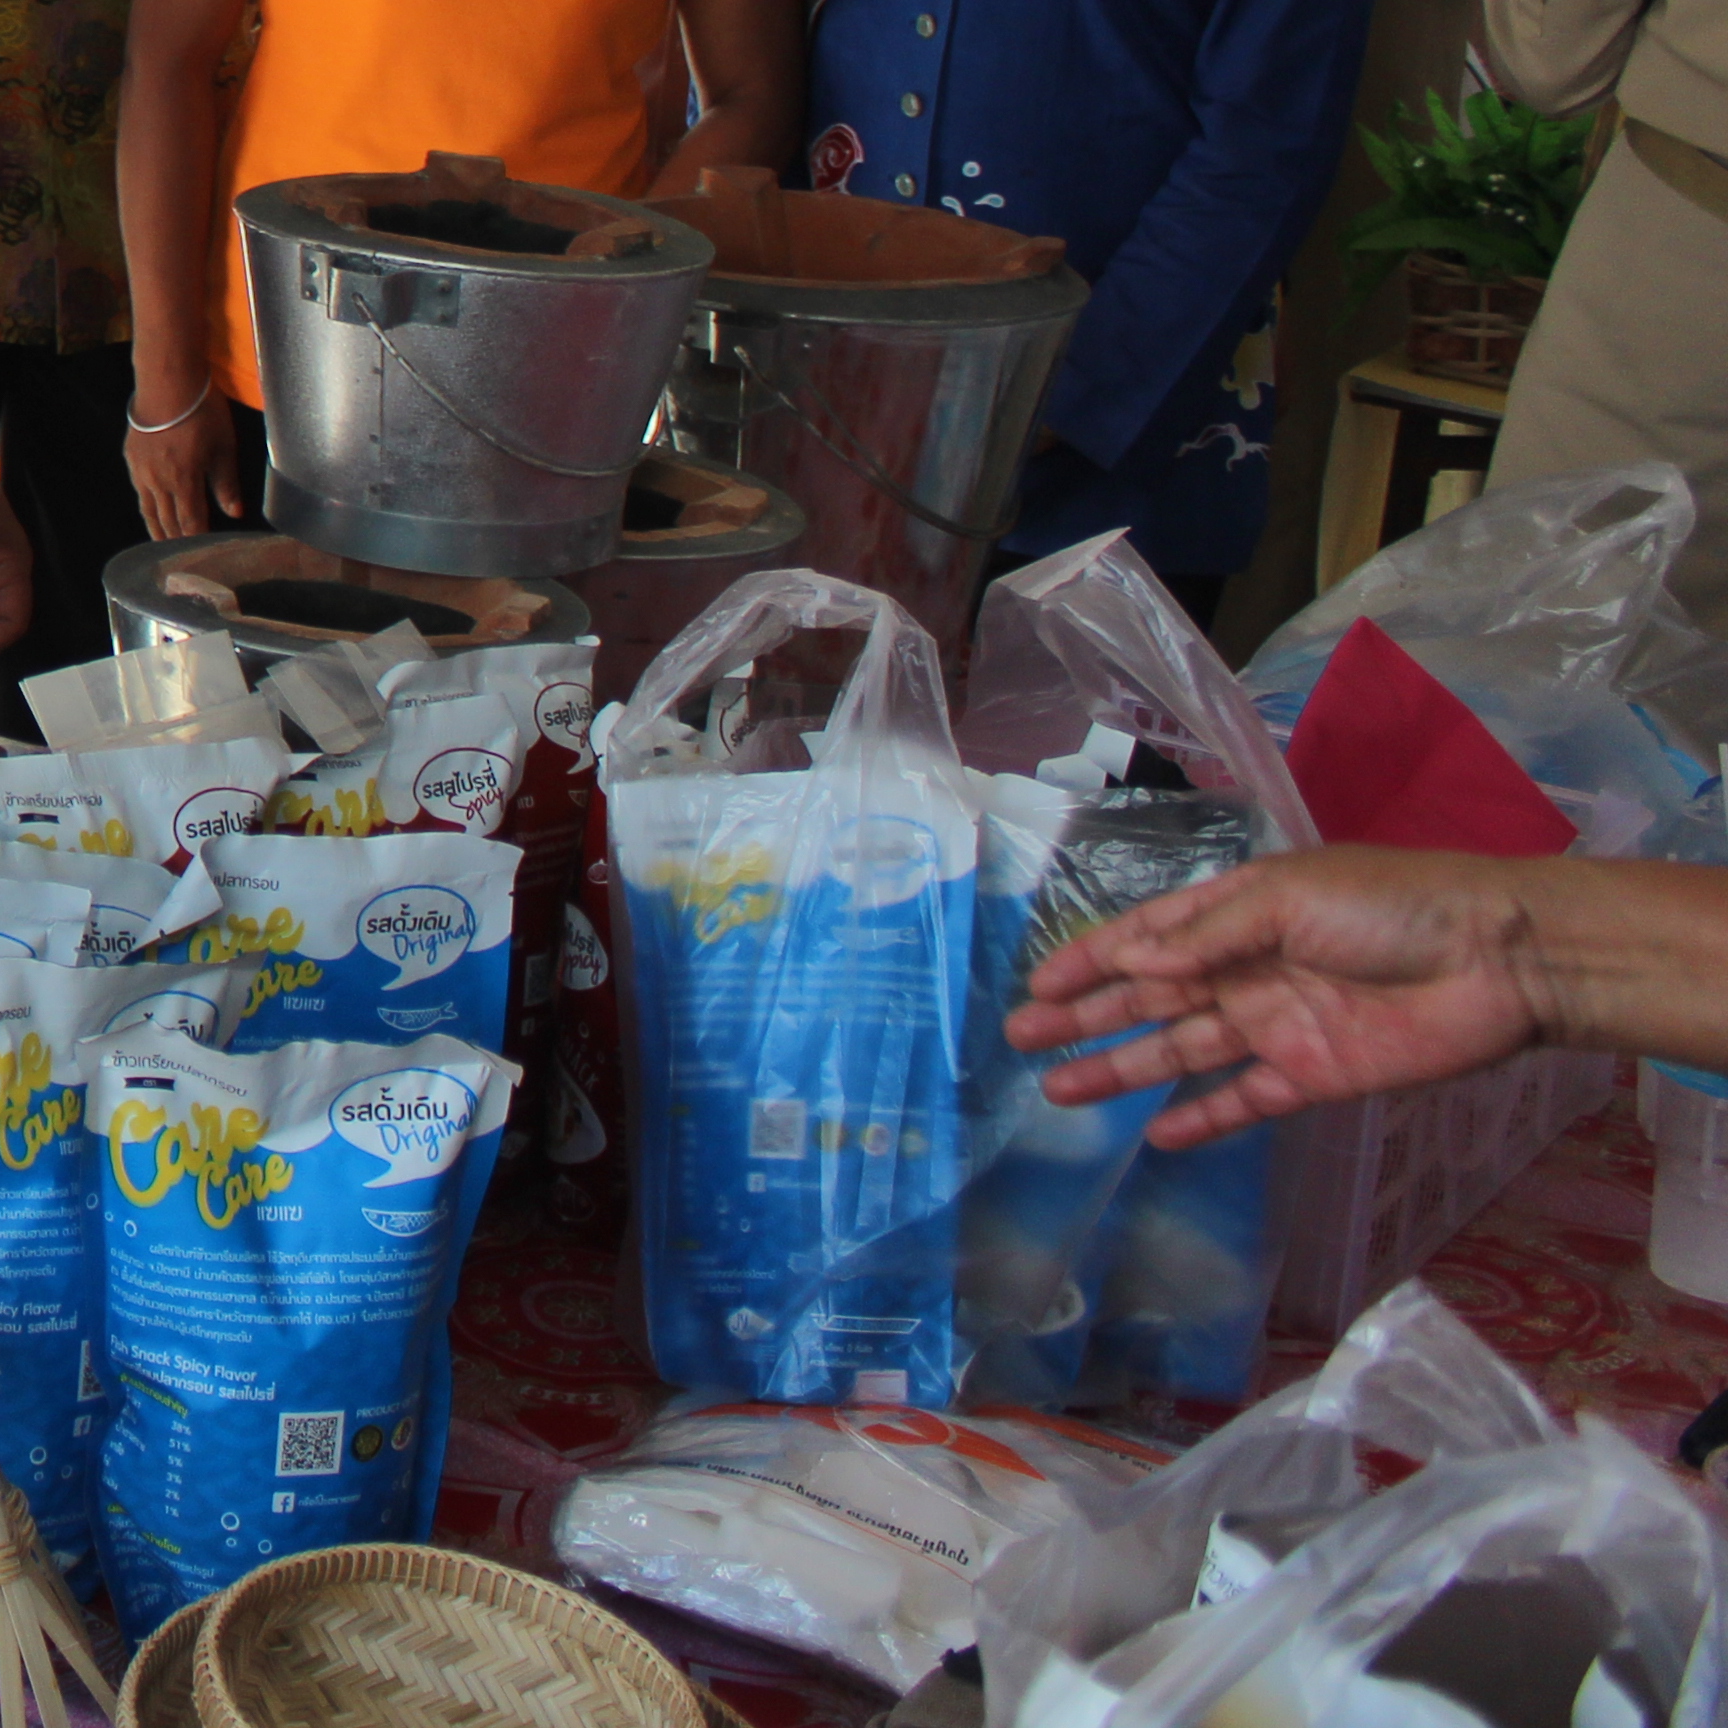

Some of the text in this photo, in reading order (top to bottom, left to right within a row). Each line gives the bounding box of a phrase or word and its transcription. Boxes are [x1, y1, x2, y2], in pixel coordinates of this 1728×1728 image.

[367, 903, 452, 934] รสดั้งเดิม
[392, 903, 476, 964] Original
[342, 1087, 449, 1123] รสดั้งเดิม
[375, 1093, 479, 1162] Original
[22, 1302, 62, 1316] Flavor
[131, 1345, 171, 1367] Snack
[173, 1355, 211, 1377] Spicy
[214, 1364, 258, 1383] Flavor
[169, 1437, 191, 1453] 51%
